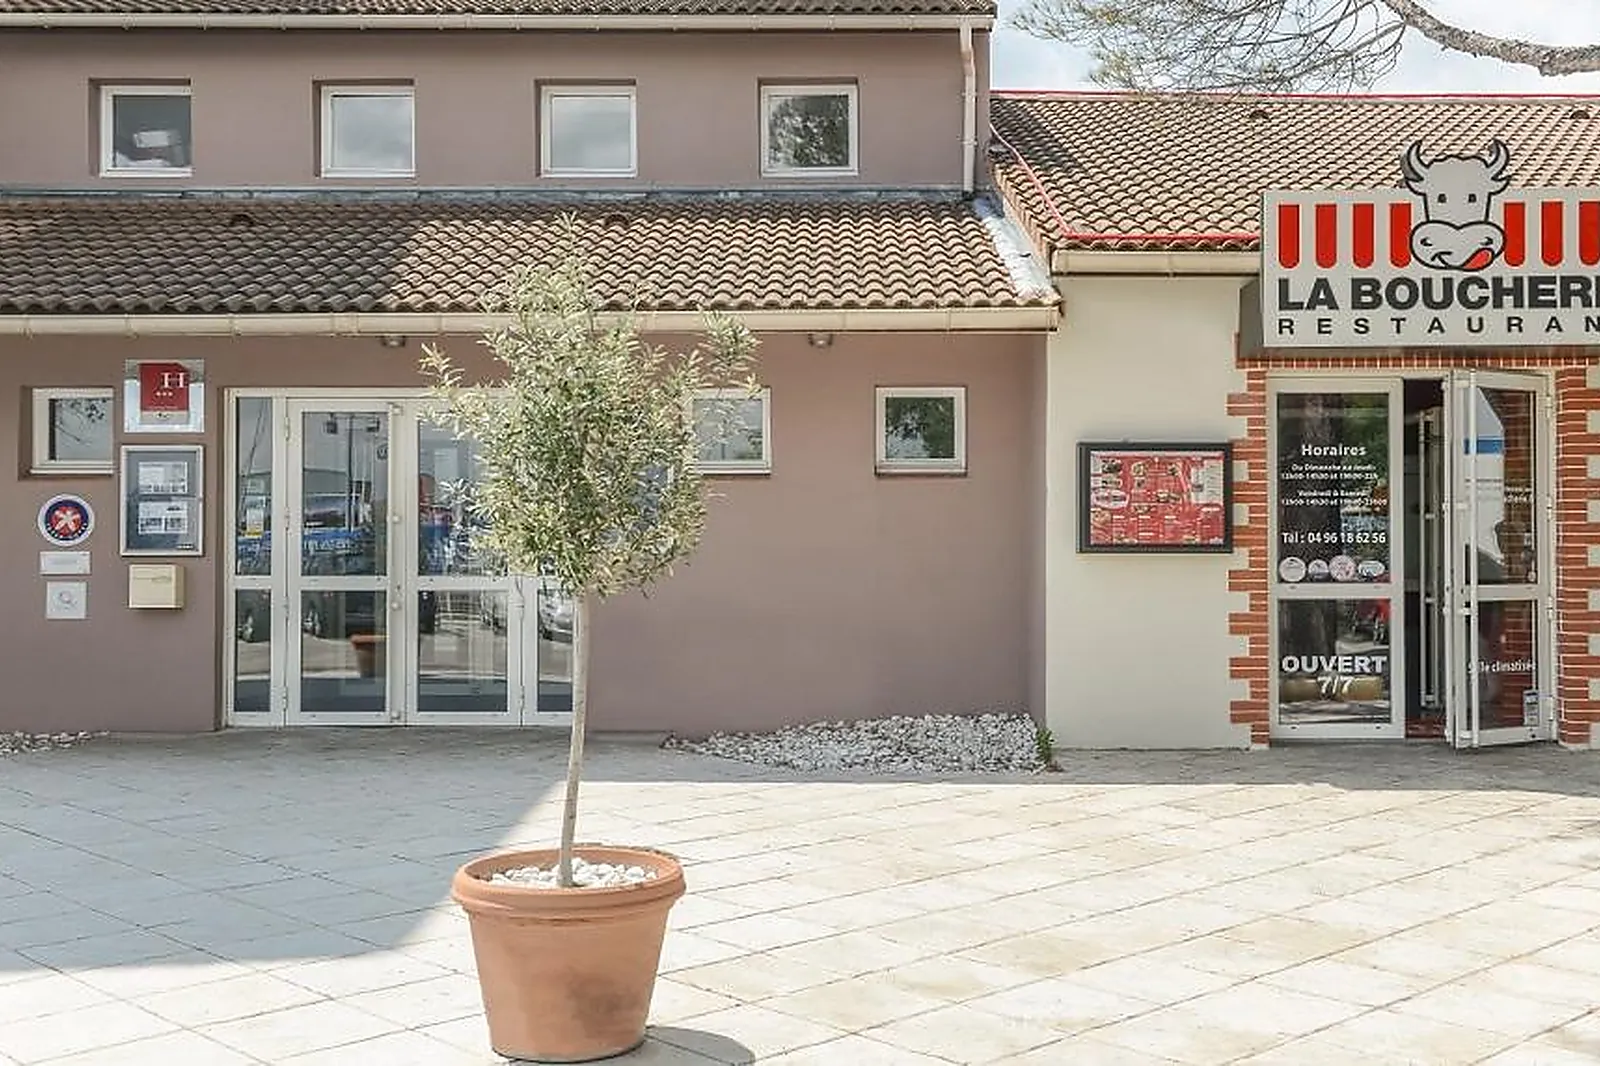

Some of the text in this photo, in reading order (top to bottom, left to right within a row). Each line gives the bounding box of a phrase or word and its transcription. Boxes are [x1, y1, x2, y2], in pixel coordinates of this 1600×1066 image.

[1278, 277, 1339, 311] LA
[1278, 315, 1600, 335] RESTAURAN
[161, 373, 186, 389] H
[1301, 443, 1367, 456] Horaires
[1308, 532, 1322, 543] 04
[1340, 532, 1354, 543] 18
[1355, 532, 1370, 543] 62
[1371, 532, 1386, 543] 56
[1281, 656, 1388, 674] OUVERT
[1316, 676, 1354, 694] 7/7
